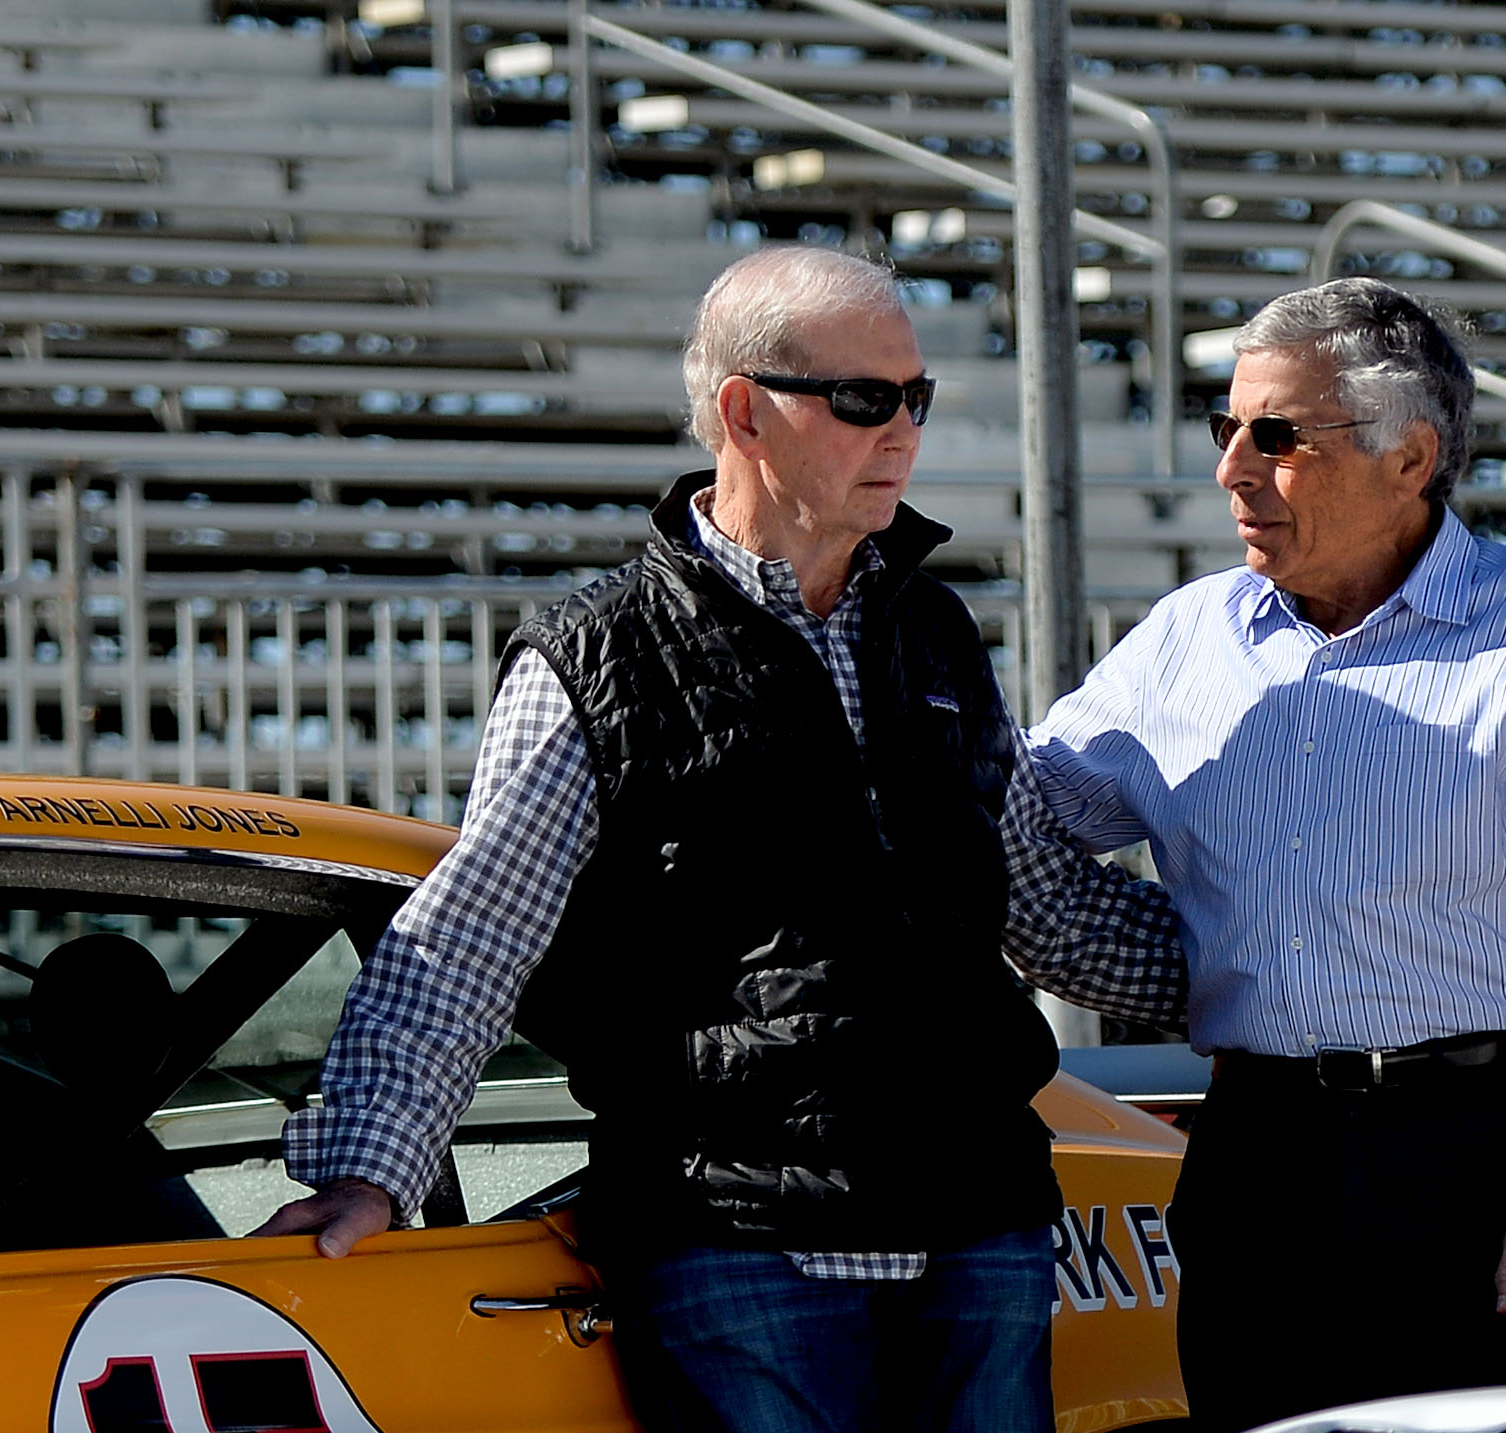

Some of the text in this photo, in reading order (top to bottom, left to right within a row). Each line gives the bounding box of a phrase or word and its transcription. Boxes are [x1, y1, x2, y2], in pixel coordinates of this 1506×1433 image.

[178, 803, 301, 838] JONES
[1051, 1204, 1181, 1314] RK F
